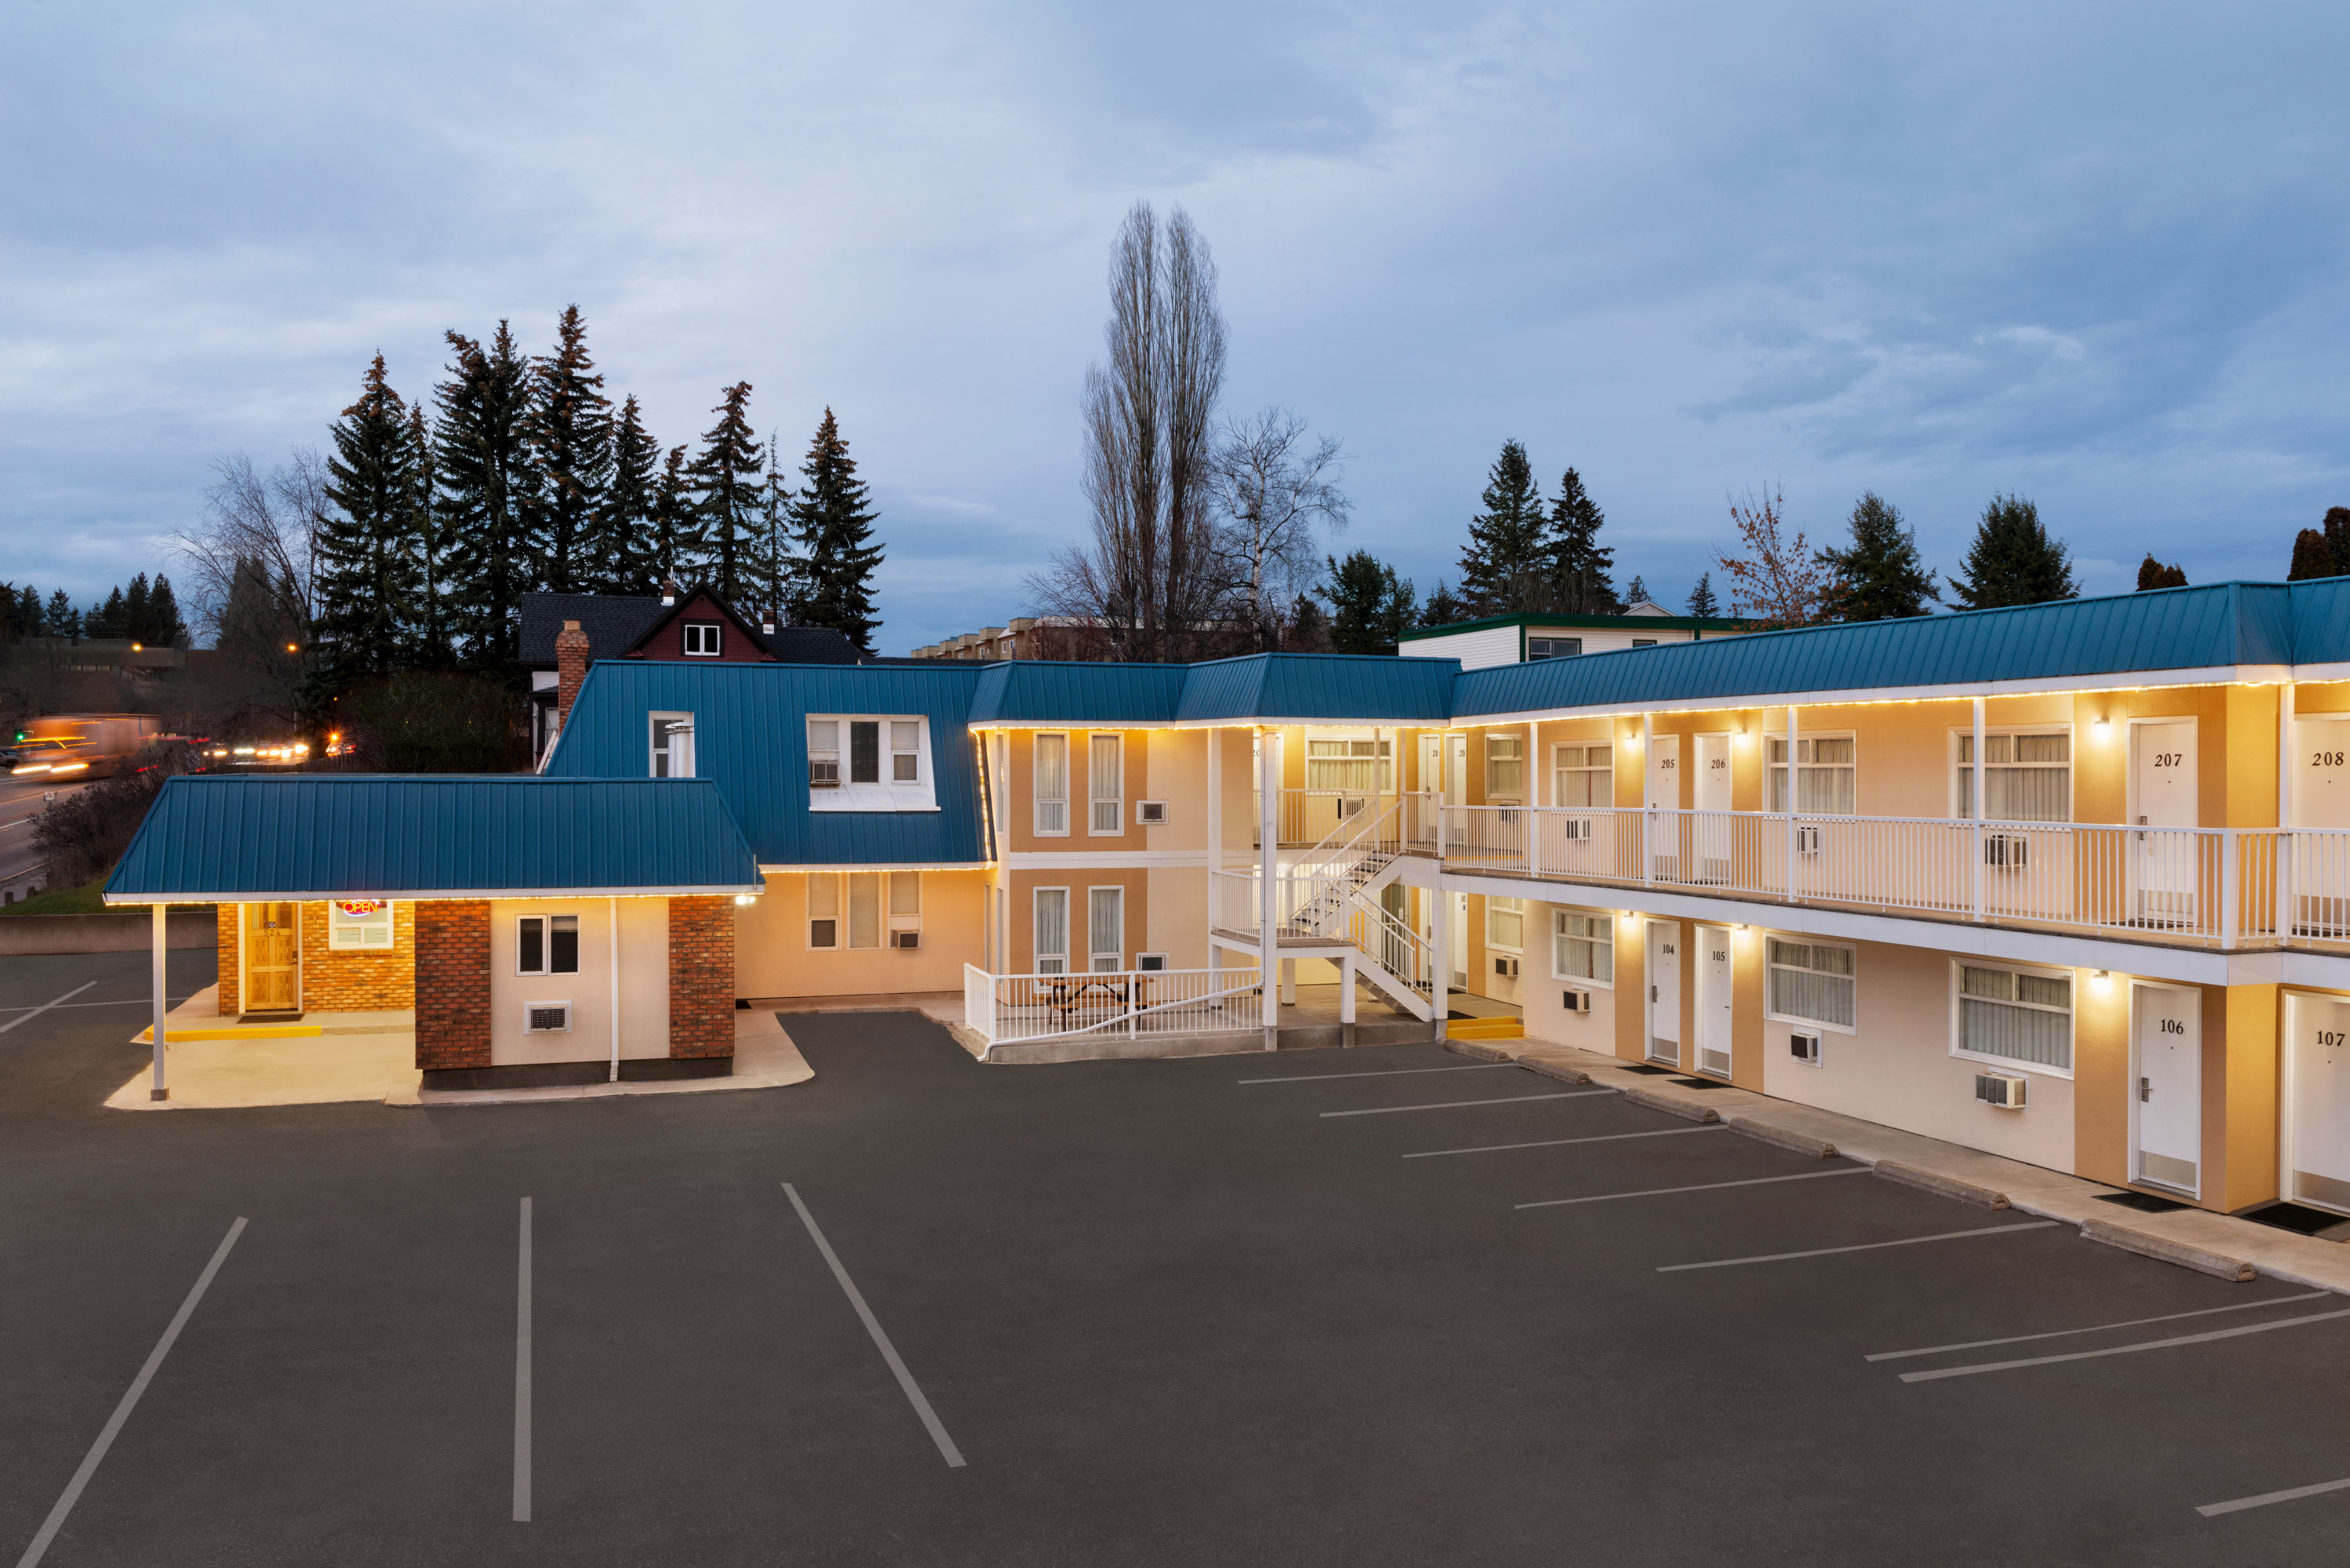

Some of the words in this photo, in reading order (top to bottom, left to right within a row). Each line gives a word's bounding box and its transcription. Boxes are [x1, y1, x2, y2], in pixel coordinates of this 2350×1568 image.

[1661, 759, 1675, 768] 205
[1711, 758, 1726, 769] 206
[2154, 753, 2182, 767] 207
[2312, 752, 2345, 766] 208
[343, 901, 378, 912] OPEN
[1662, 944, 1675, 955] 104
[1712, 950, 1726, 962] 105
[2160, 1019, 2184, 1035] 106
[2317, 1030, 2346, 1047] 107
